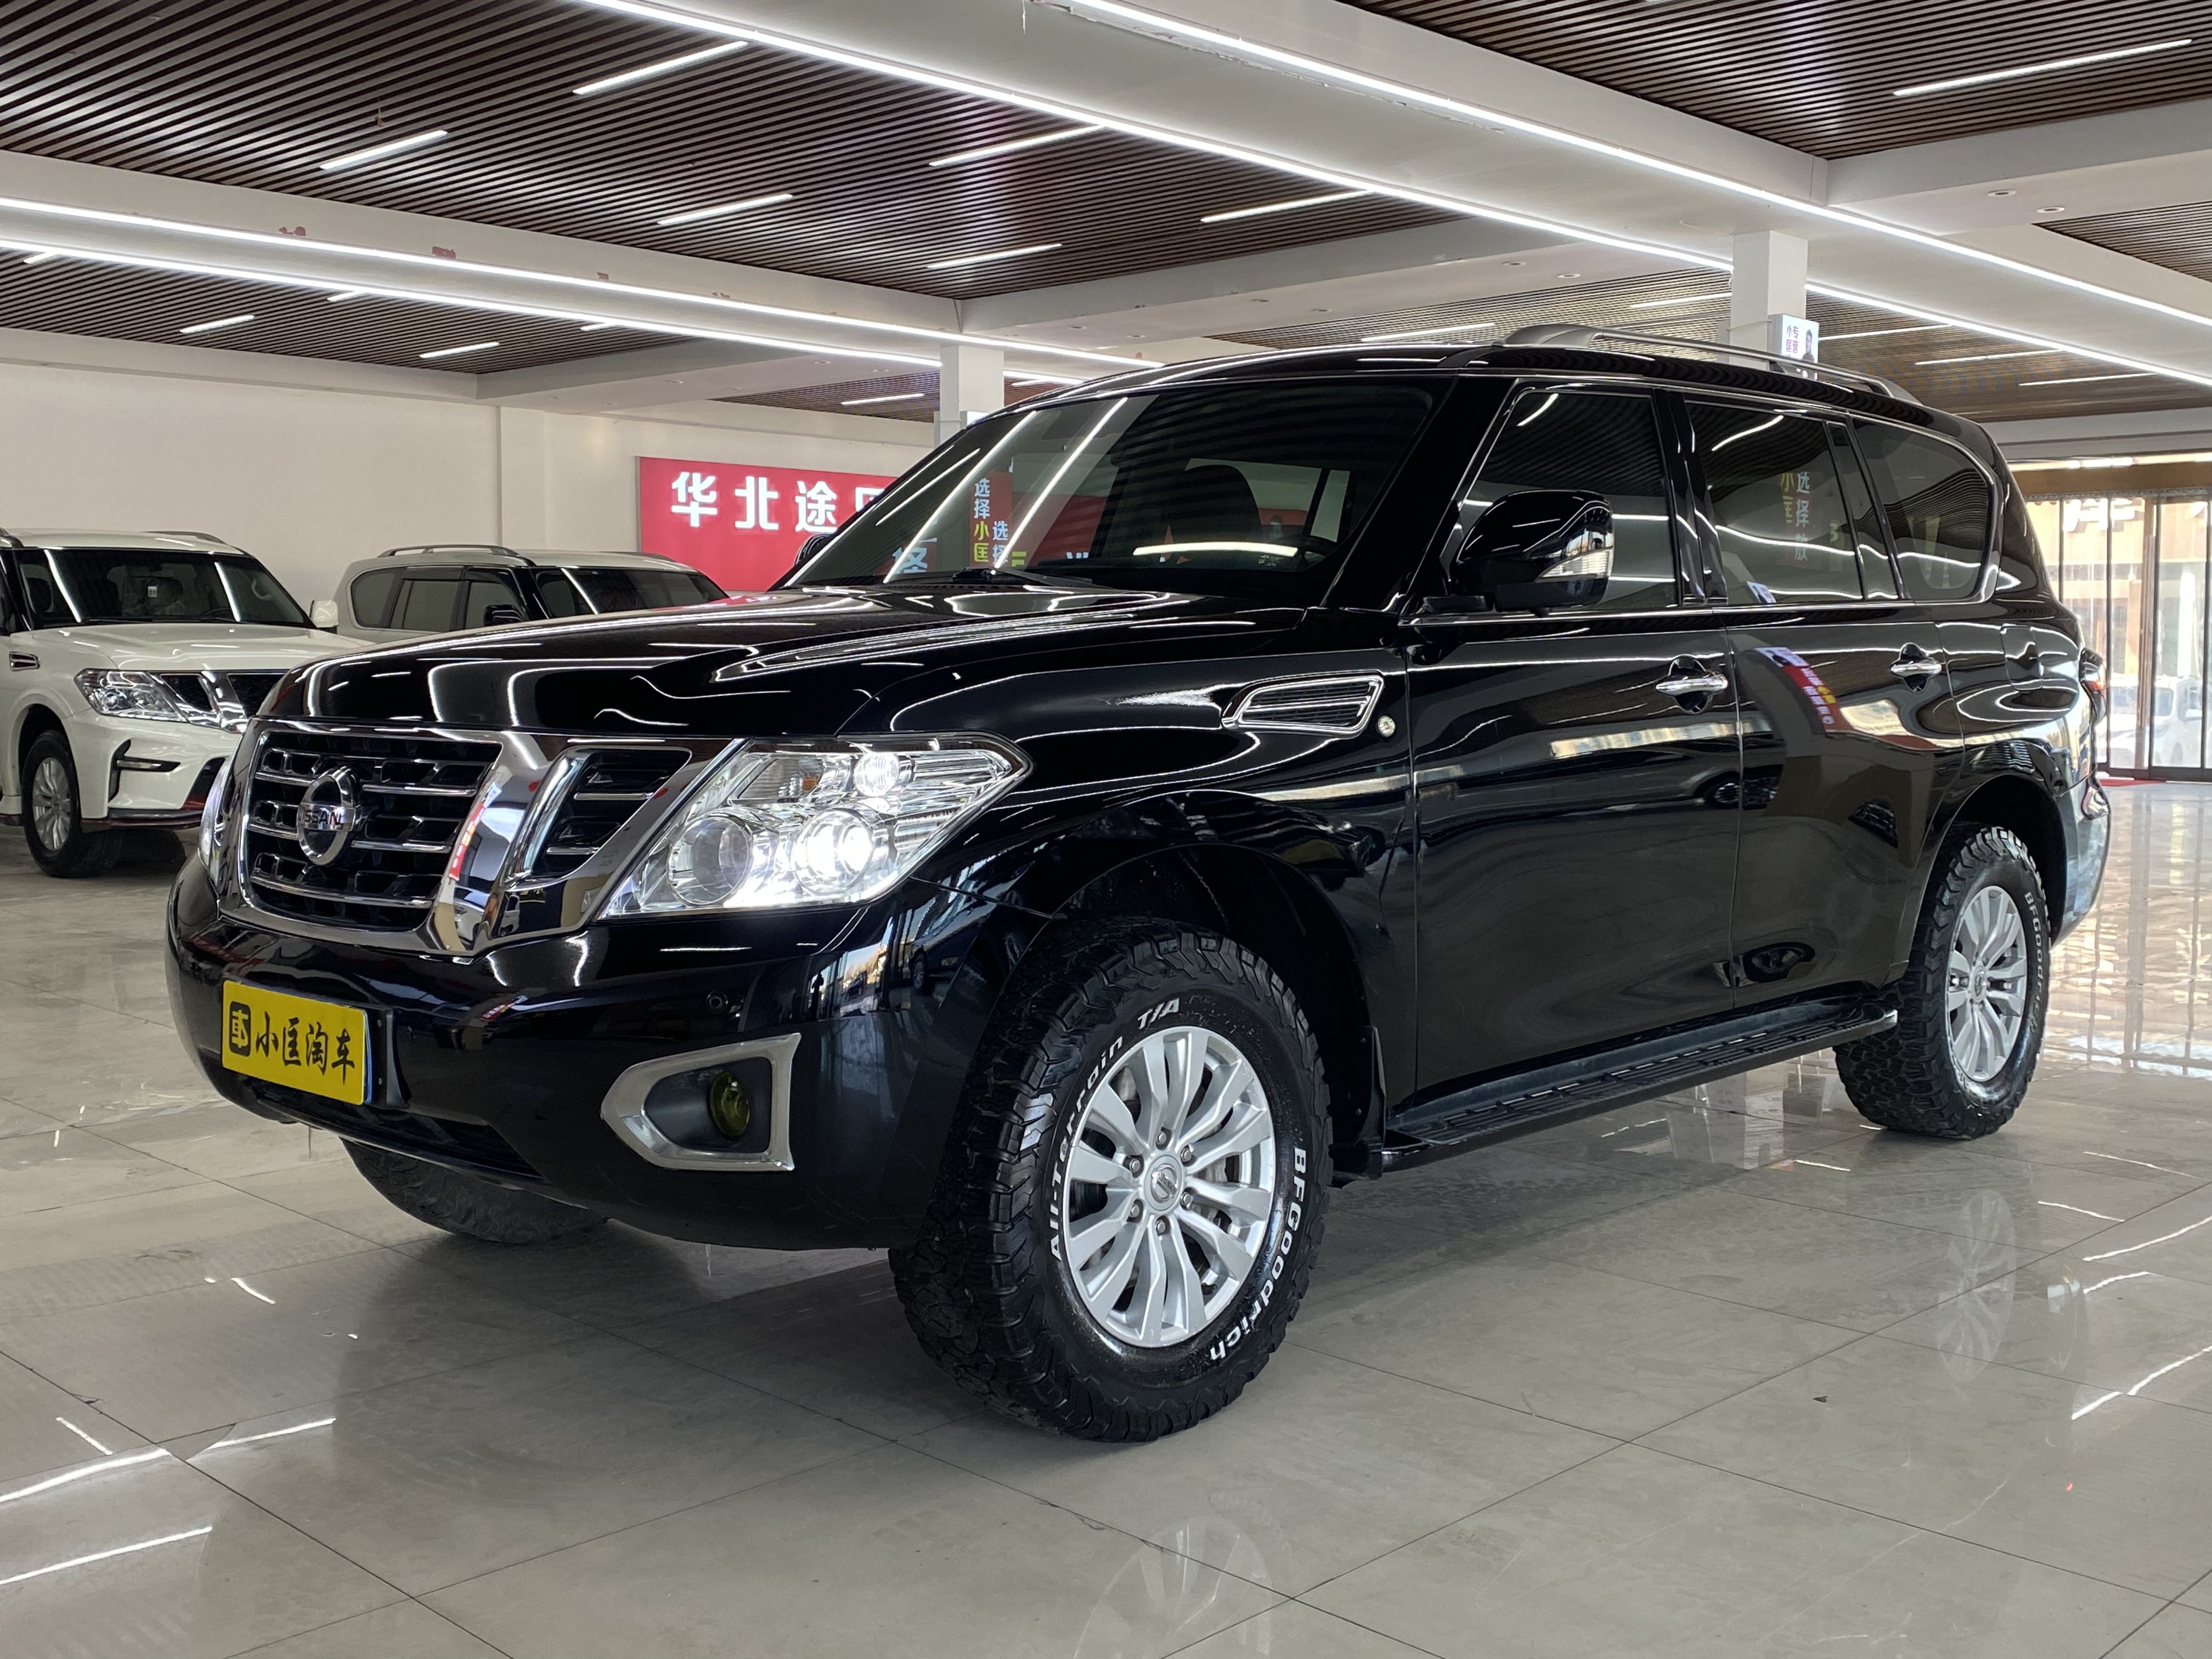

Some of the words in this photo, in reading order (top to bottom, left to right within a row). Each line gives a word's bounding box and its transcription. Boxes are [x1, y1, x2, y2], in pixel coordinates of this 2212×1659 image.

[973, 477, 990, 563] 选择小匡
[1137, 997, 1180, 1030] T/A
[1209, 1147, 1306, 1361] BFGoodrich
